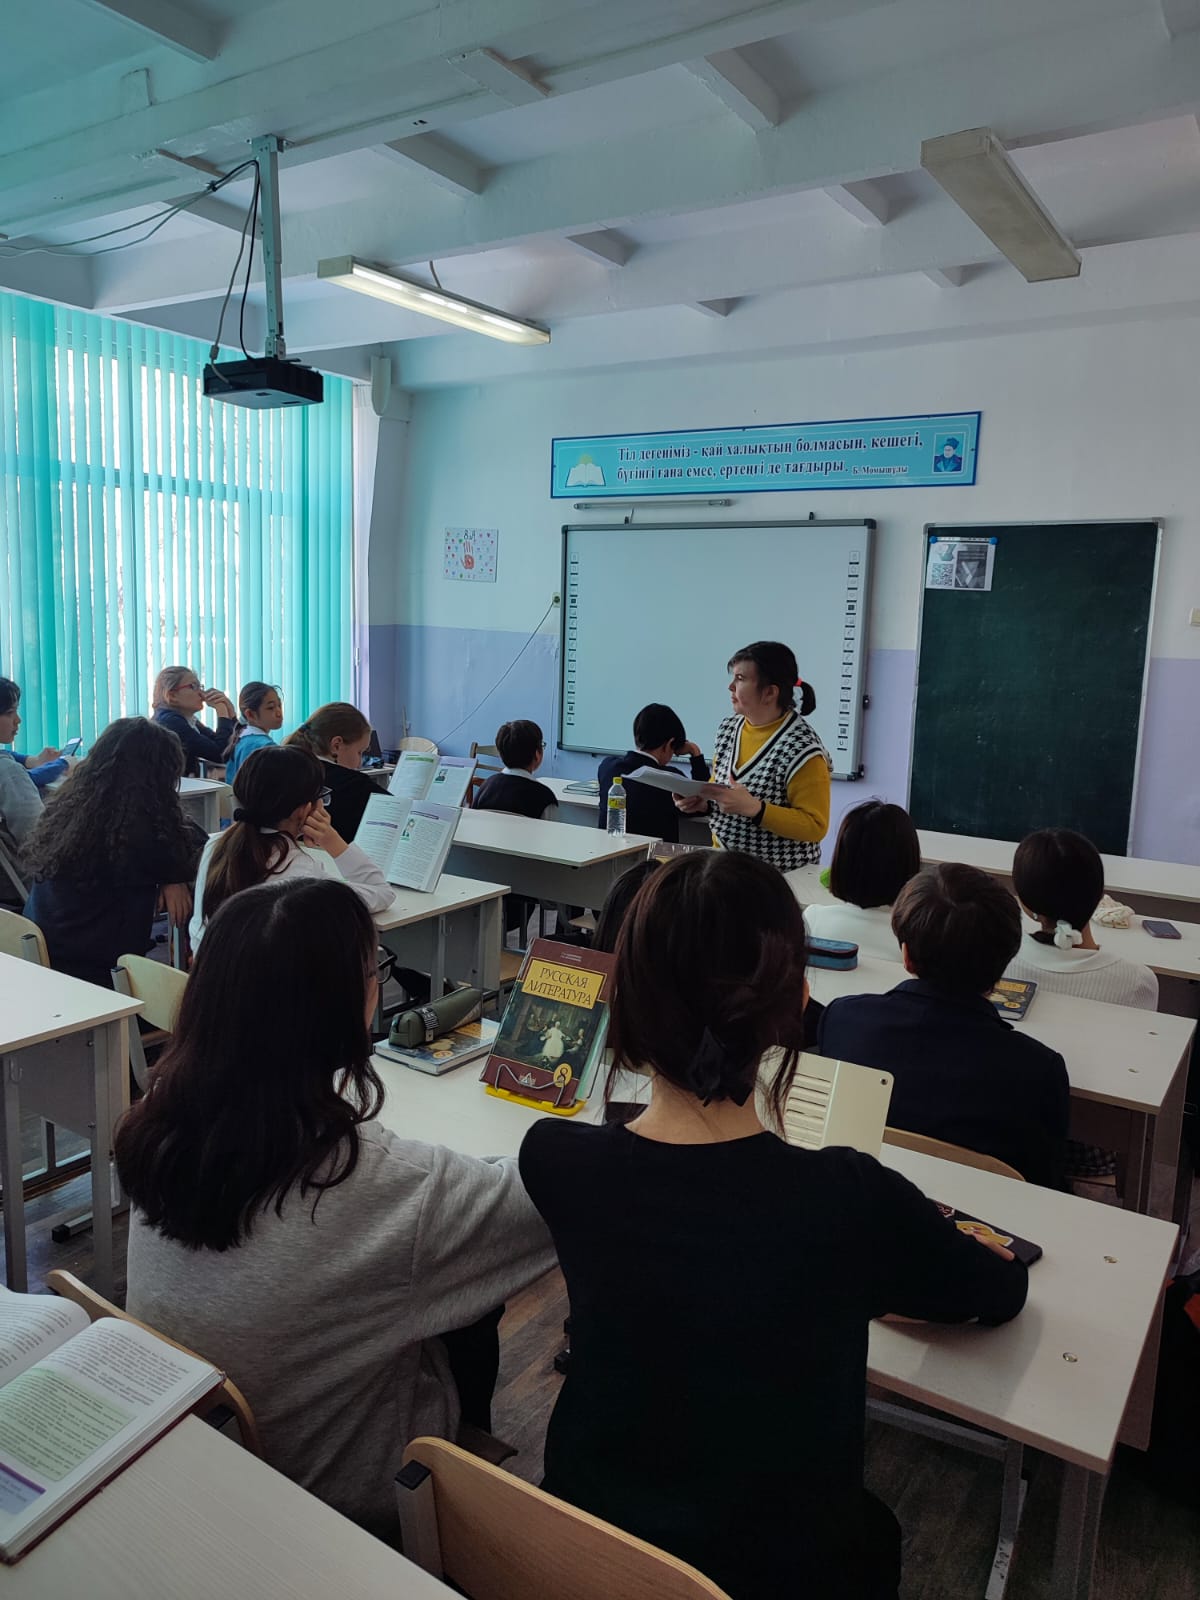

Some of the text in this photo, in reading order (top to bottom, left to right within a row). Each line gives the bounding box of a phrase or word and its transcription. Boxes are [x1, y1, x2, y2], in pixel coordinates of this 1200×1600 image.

[618, 447, 636, 461] Тіл
[639, 444, 691, 460] дегеніміз
[727, 440, 794, 456] халықтың
[617, 466, 655, 483] бүгінгі
[686, 465, 717, 479] емес,
[720, 461, 765, 480] ертеңгі
[768, 463, 781, 476] де
[785, 460, 849, 476] тағдыры.
[540, 967, 589, 989] РУССКАЯ
[525, 979, 591, 1006] ЛИТЕРАТУРА
[557, 1066, 569, 1084] 8
